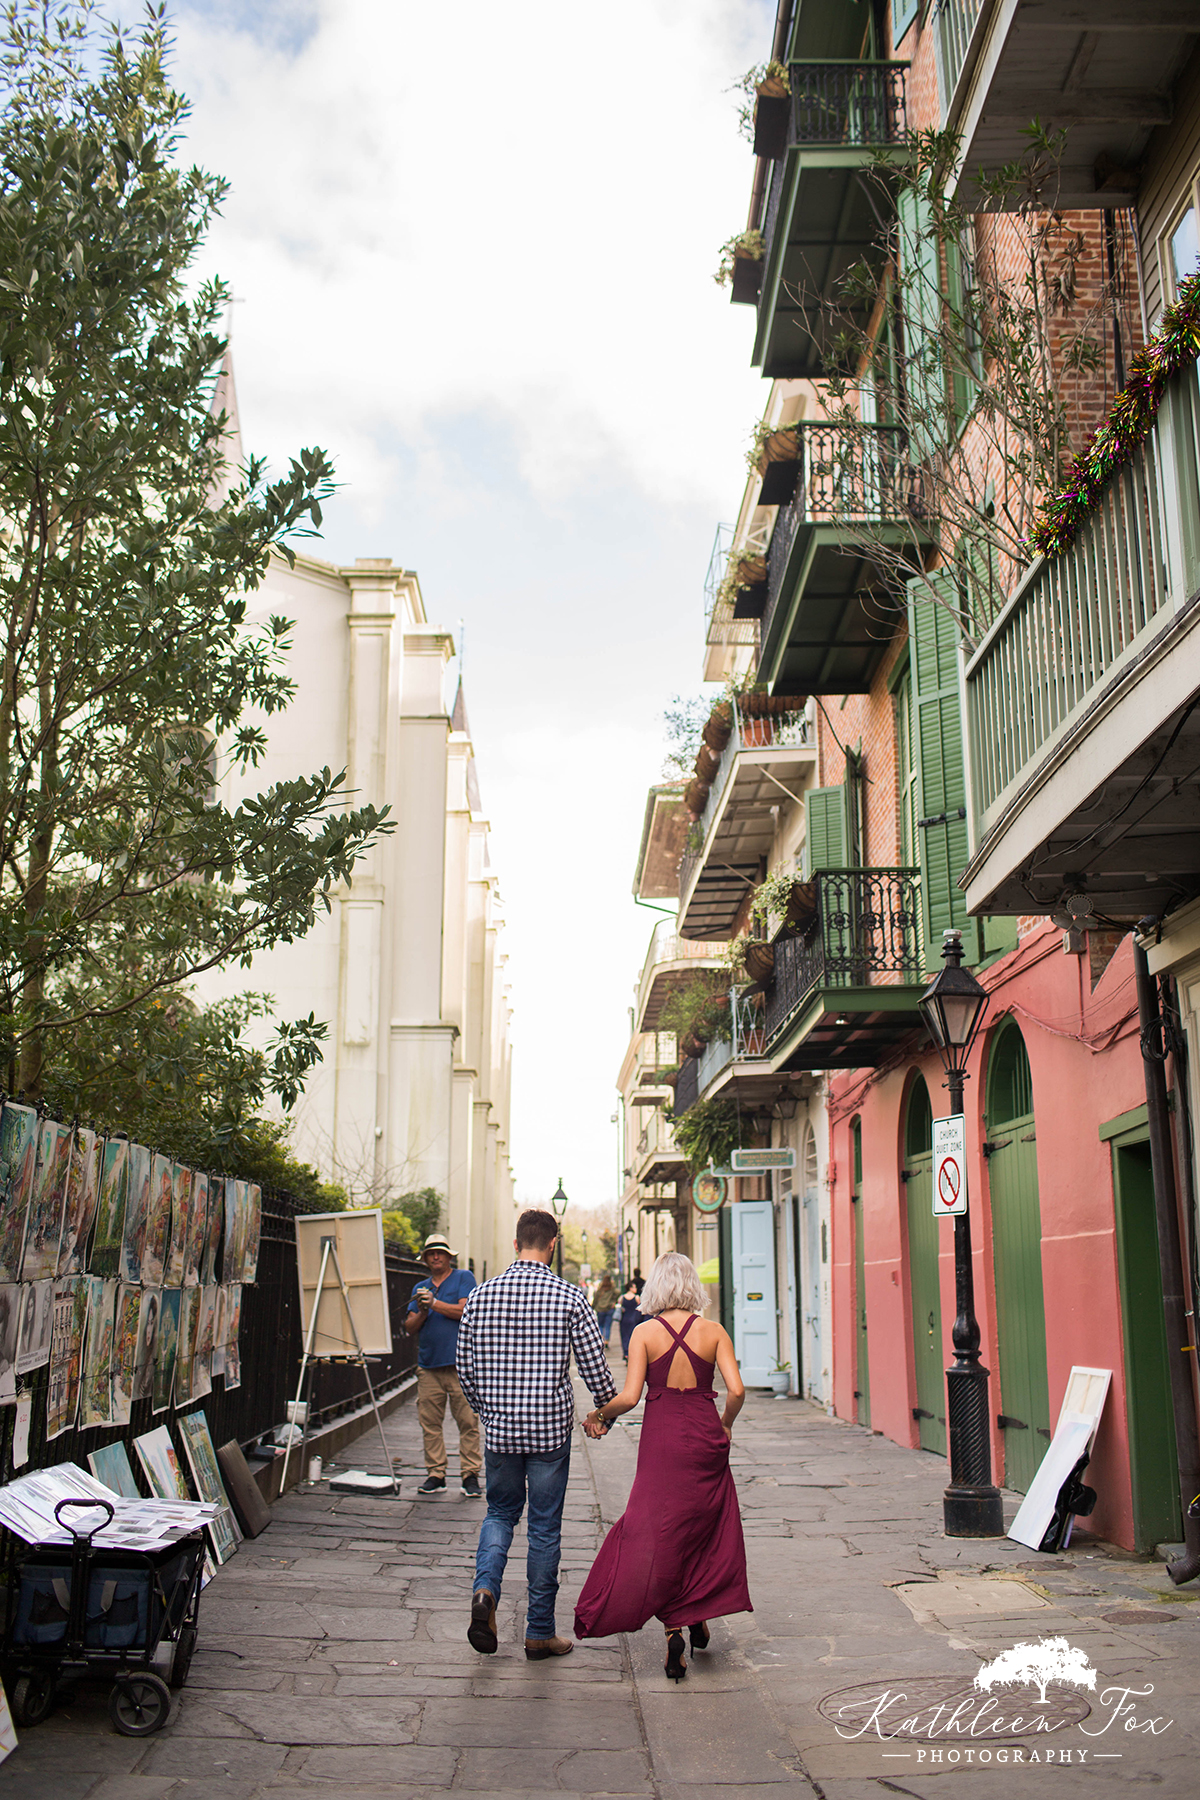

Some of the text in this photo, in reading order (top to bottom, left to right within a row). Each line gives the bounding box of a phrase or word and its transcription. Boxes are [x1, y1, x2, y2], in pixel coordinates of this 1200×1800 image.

[940, 1129, 958, 1140] CHURCH
[936, 1141, 962, 1153] QUIET ZONE
